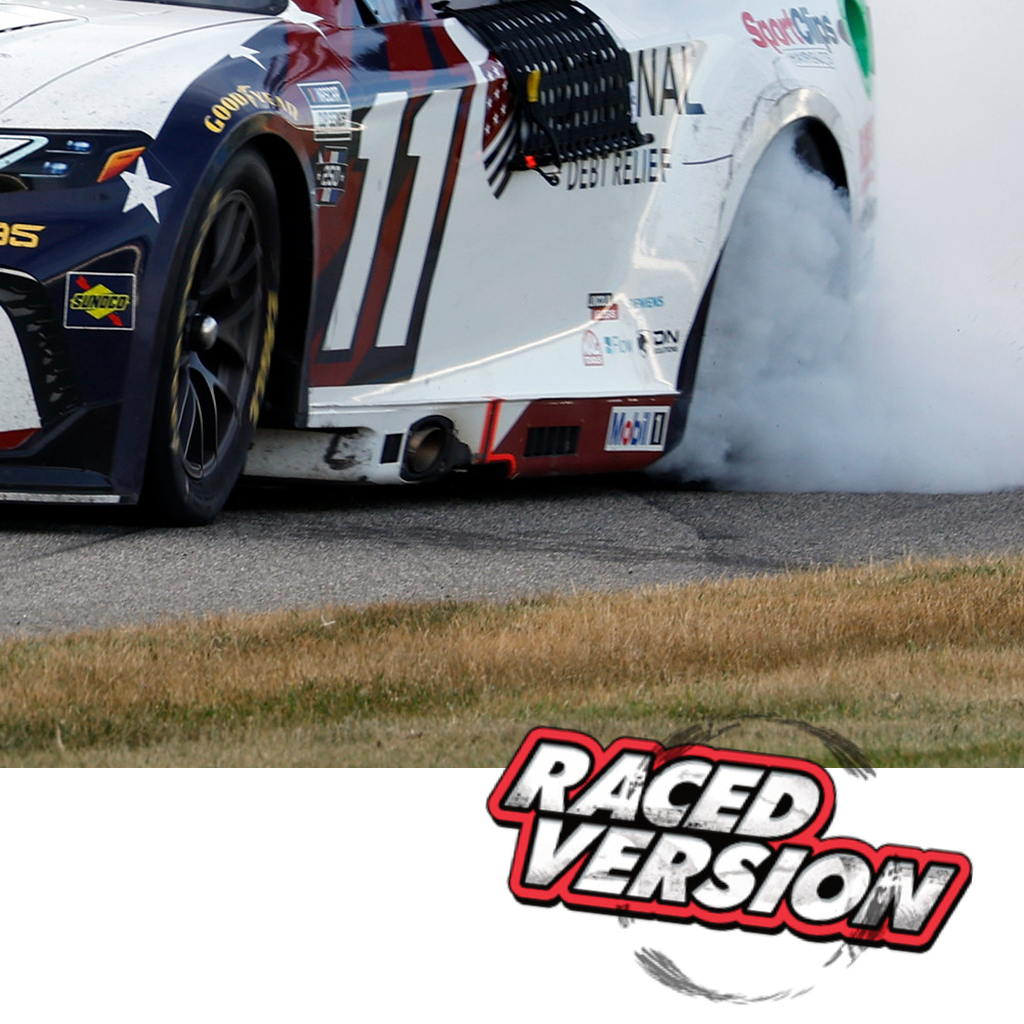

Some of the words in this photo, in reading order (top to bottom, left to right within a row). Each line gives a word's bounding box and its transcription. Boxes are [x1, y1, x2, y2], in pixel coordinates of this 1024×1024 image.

[203, 84, 299, 135] GOODYEAR
[612, 148, 671, 187] RELIEF
[322, 89, 464, 352] 11
[73, 292, 127, 311] SUNOCO
